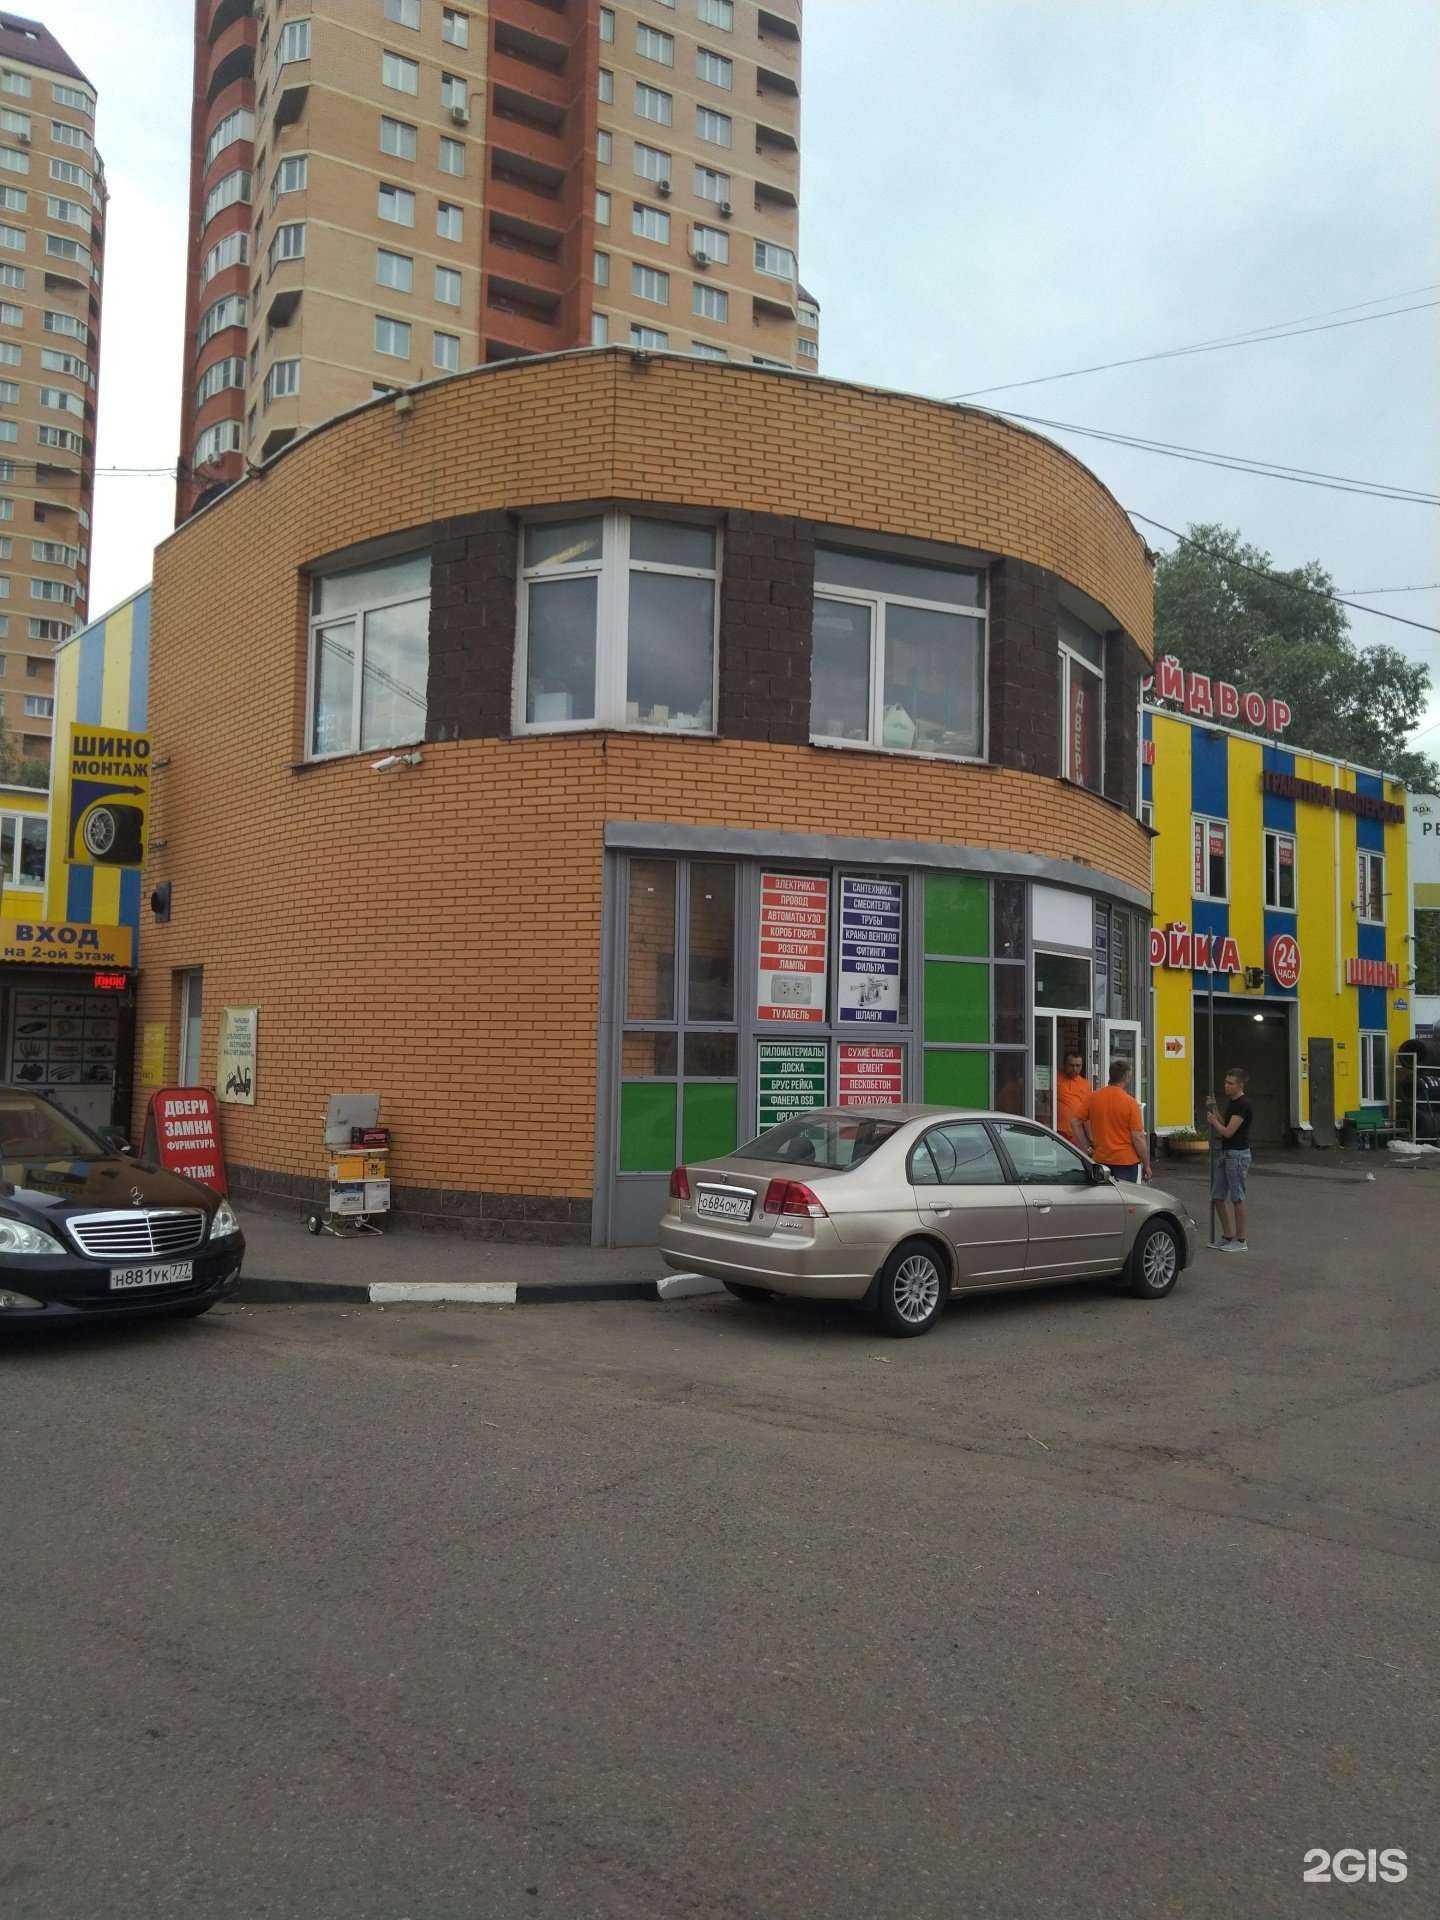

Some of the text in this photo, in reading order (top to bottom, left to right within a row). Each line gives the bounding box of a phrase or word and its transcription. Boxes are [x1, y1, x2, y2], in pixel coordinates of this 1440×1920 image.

[1142, 655, 1291, 735] ЙДВОР
[73, 736, 150, 758] ШИНО
[72, 761, 148, 777] МОНТАЖ
[775, 879, 816, 891] ЭЛЕКТРИКА
[852, 882, 893, 895] САНТЕХНИКА
[781, 895, 809, 908] ПРОВОД
[853, 898, 891, 911] СМЕСИТЕЛИ
[767, 910, 821, 924] АВТОМАТЫ УЗО
[861, 915, 883, 925] ТРУБЫ
[16, 925, 99, 949] ВХОД
[770, 927, 817, 940] КОРОБ ГОФРА
[845, 930, 897, 943] КРАНЫ ВЕНТИЛЯ
[777, 944, 808, 955] РОЗЕТКИ
[856, 946, 886, 957] ФИТИНГИ
[1150, 921, 1242, 973] ОЙКА
[4, 947, 116, 962] на 2-ой этаж
[1278, 943, 1297, 968] 24
[779, 960, 807, 970] ЛАМПЫ
[855, 962, 885, 973] ФИЛЬТРА
[1278, 969, 1297, 979] ЧАСА
[1346, 958, 1400, 988] ШИНЫ
[772, 1008, 810, 1020] TV КАБЕЛЬ
[855, 1010, 882, 1021] ШЛАНГИ
[761, 1046, 824, 1057] ПИЛОМАТЕРИАЛЫ
[847, 1047, 894, 1058] СУХИЕ СМЕСИ
[780, 1062, 805, 1073] ДОСКА
[857, 1063, 884, 1073] ЦЕМЕНТ
[771, 1078, 813, 1090] БРУС РЕЙКА
[849, 1080, 891, 1090] ПЕСКОБЕТОН
[770, 1095, 814, 1105] ФАНЕРА OSB
[847, 1095, 893, 1105] ШТУКАТУРКА
[165, 1100, 209, 1118] ДВЕРИ
[165, 1119, 212, 1137] ЗАМКИ
[167, 1139, 216, 1151] ФУРНИТУРА
[183, 1164, 215, 1179] ЭТАЖ
[115, 1263, 189, 1287] Н881УК 777
